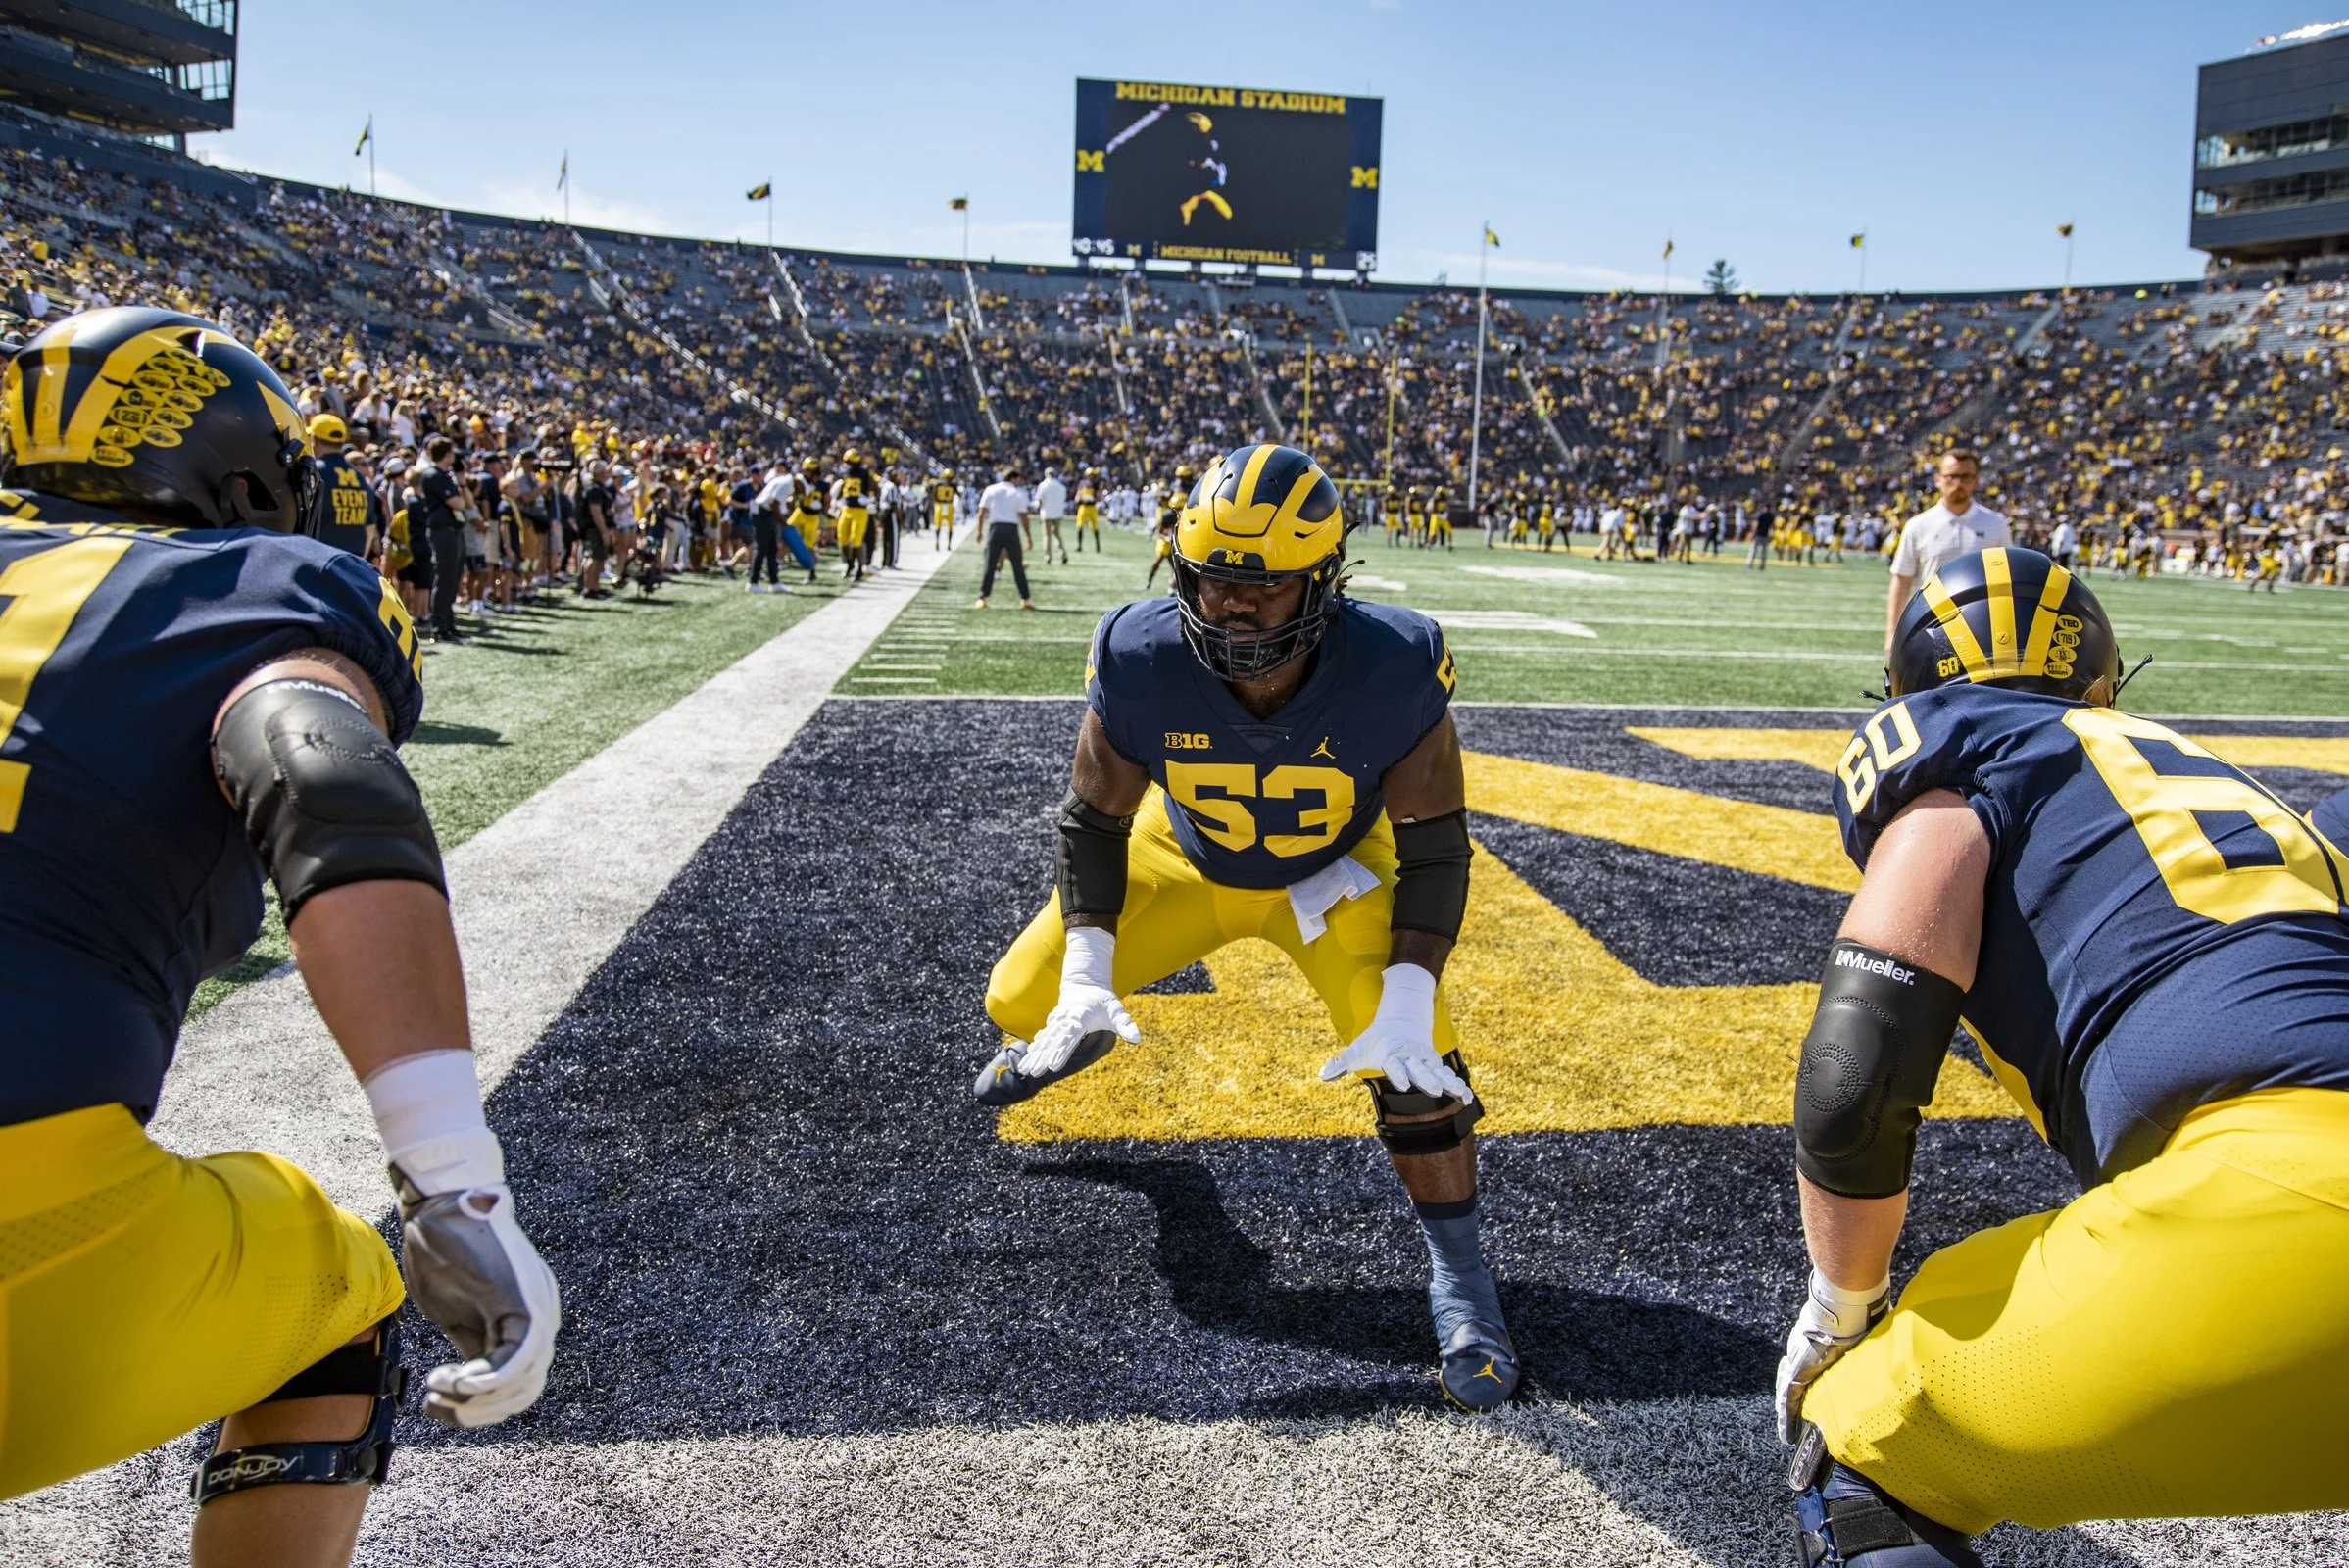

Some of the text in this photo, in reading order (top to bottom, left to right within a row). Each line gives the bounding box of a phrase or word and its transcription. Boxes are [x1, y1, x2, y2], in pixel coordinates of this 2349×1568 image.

[1116, 82, 1346, 114] MICHIGAN STADIUM
[1077, 150, 1104, 172] M
[1351, 167, 1379, 188] M
[1160, 245, 1224, 260] MICHIGAN
[1225, 247, 1292, 265] FOOTBALL
[334, 466, 360, 487] M
[331, 488, 367, 508] EVENT
[334, 506, 367, 525] TEAM
[1225, 550, 1244, 565] M
[2060, 617, 2079, 628] TED
[1937, 657, 1960, 678] 60
[1837, 701, 1922, 815] 60
[1165, 759, 1355, 858] 53
